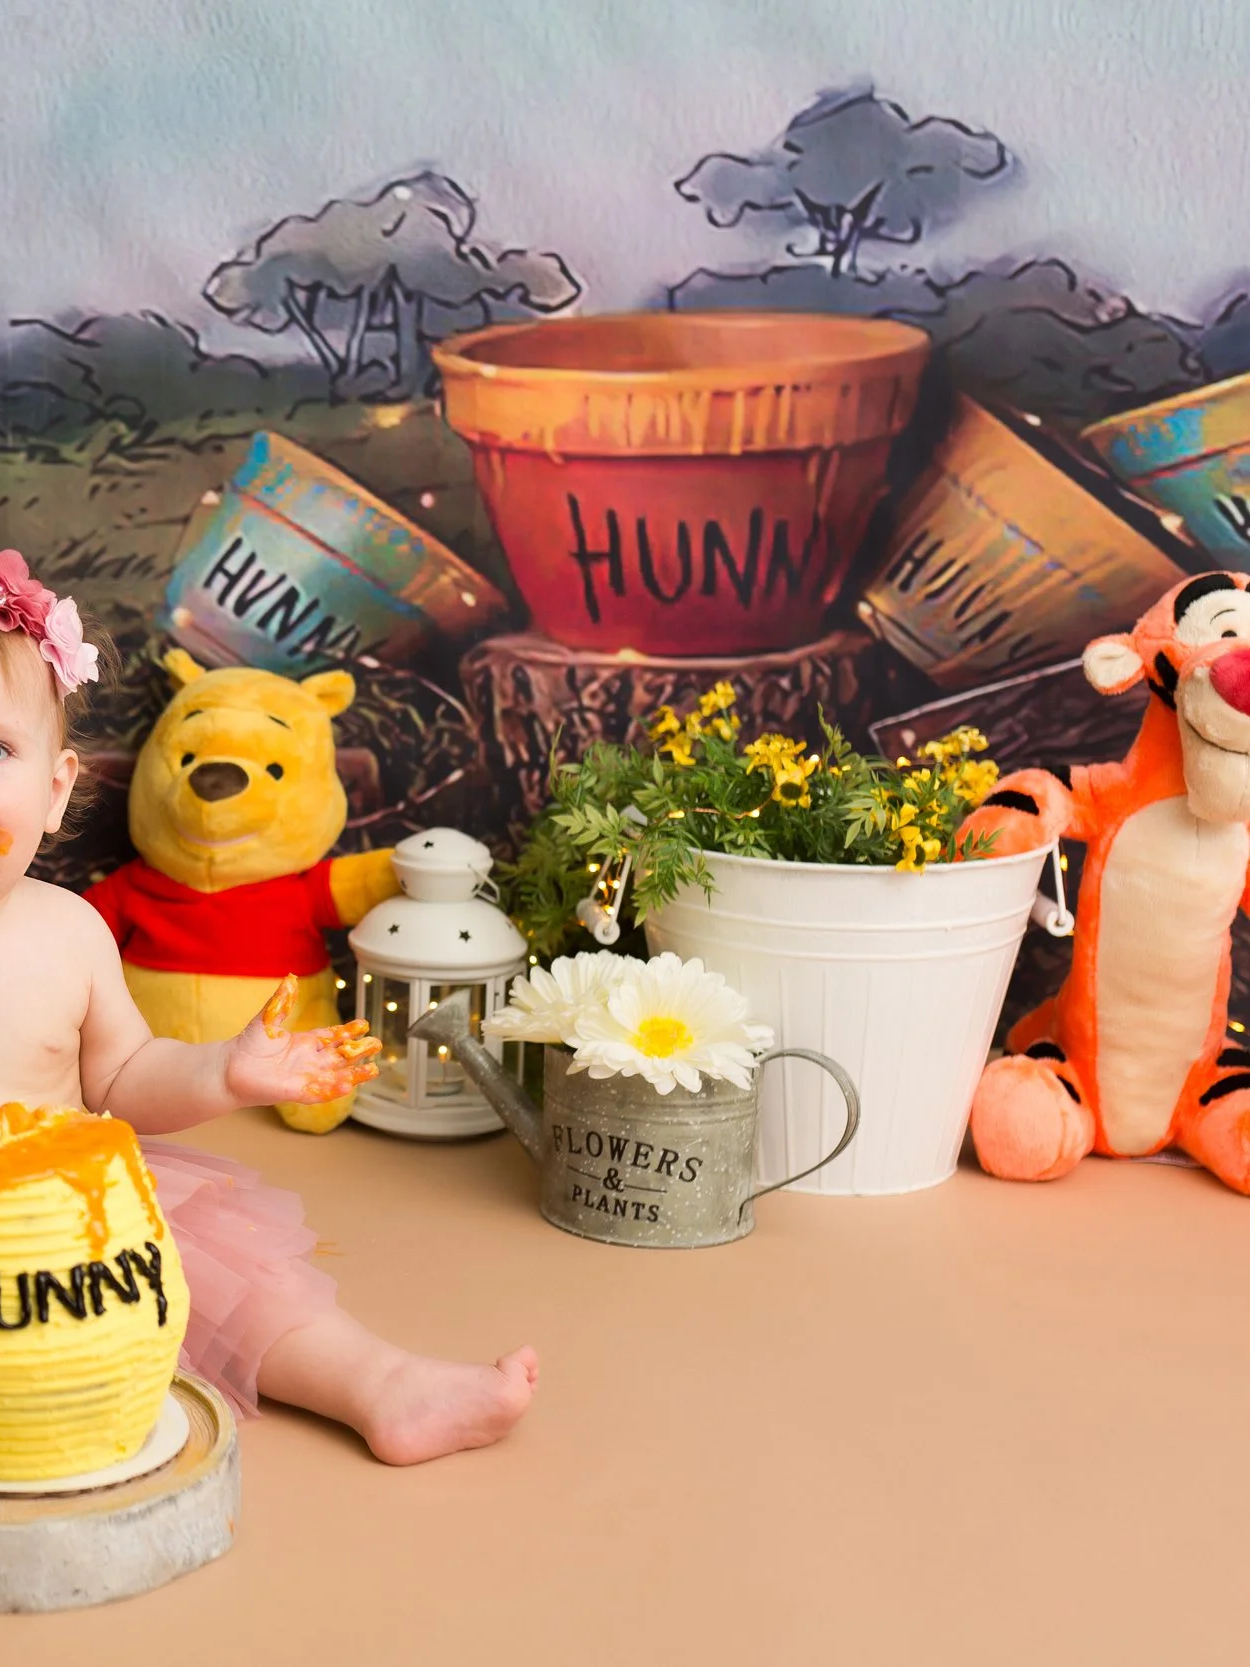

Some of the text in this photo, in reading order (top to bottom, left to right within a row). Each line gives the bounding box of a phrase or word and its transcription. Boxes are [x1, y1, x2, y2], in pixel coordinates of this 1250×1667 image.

[552, 1124, 704, 1183] FLOWERS
[602, 1167, 626, 1194] &
[572, 1183, 661, 1223] PLANTS
